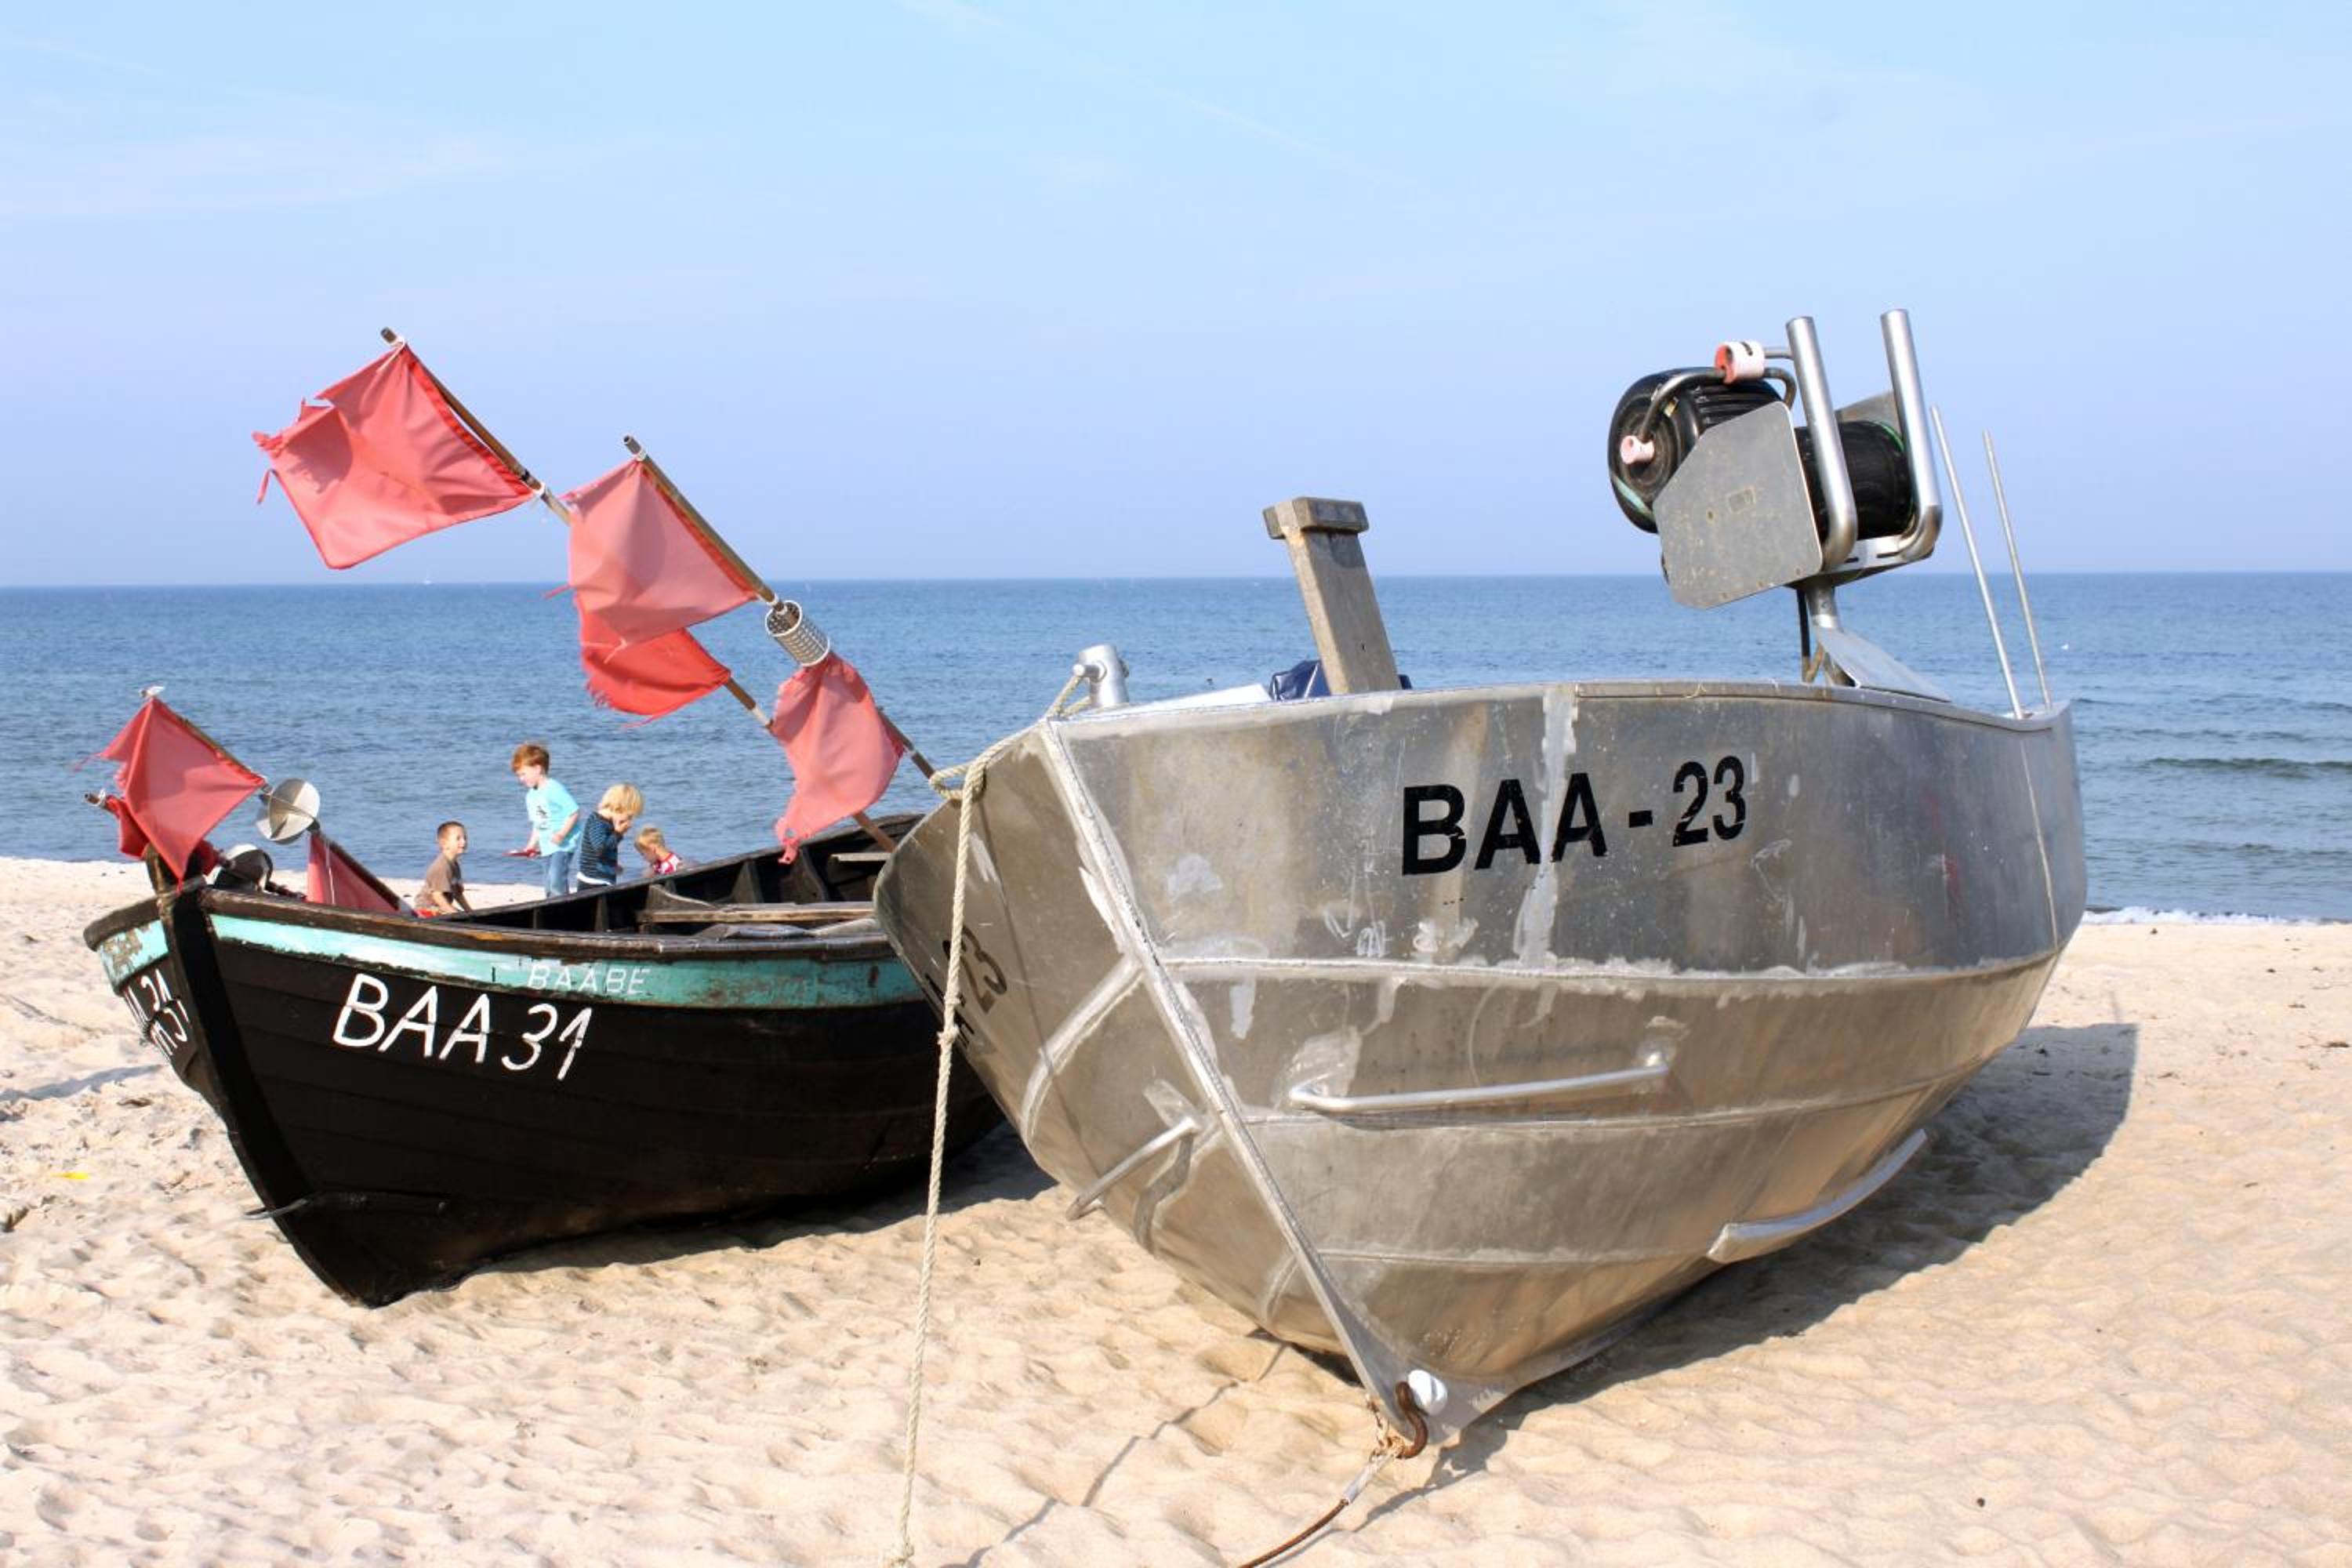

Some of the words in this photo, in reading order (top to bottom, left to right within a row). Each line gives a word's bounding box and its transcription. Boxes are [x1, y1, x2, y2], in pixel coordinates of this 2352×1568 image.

[527, 964, 652, 995] BAABE
[332, 973, 492, 1063] BAA
[501, 1003, 593, 1081] 31
